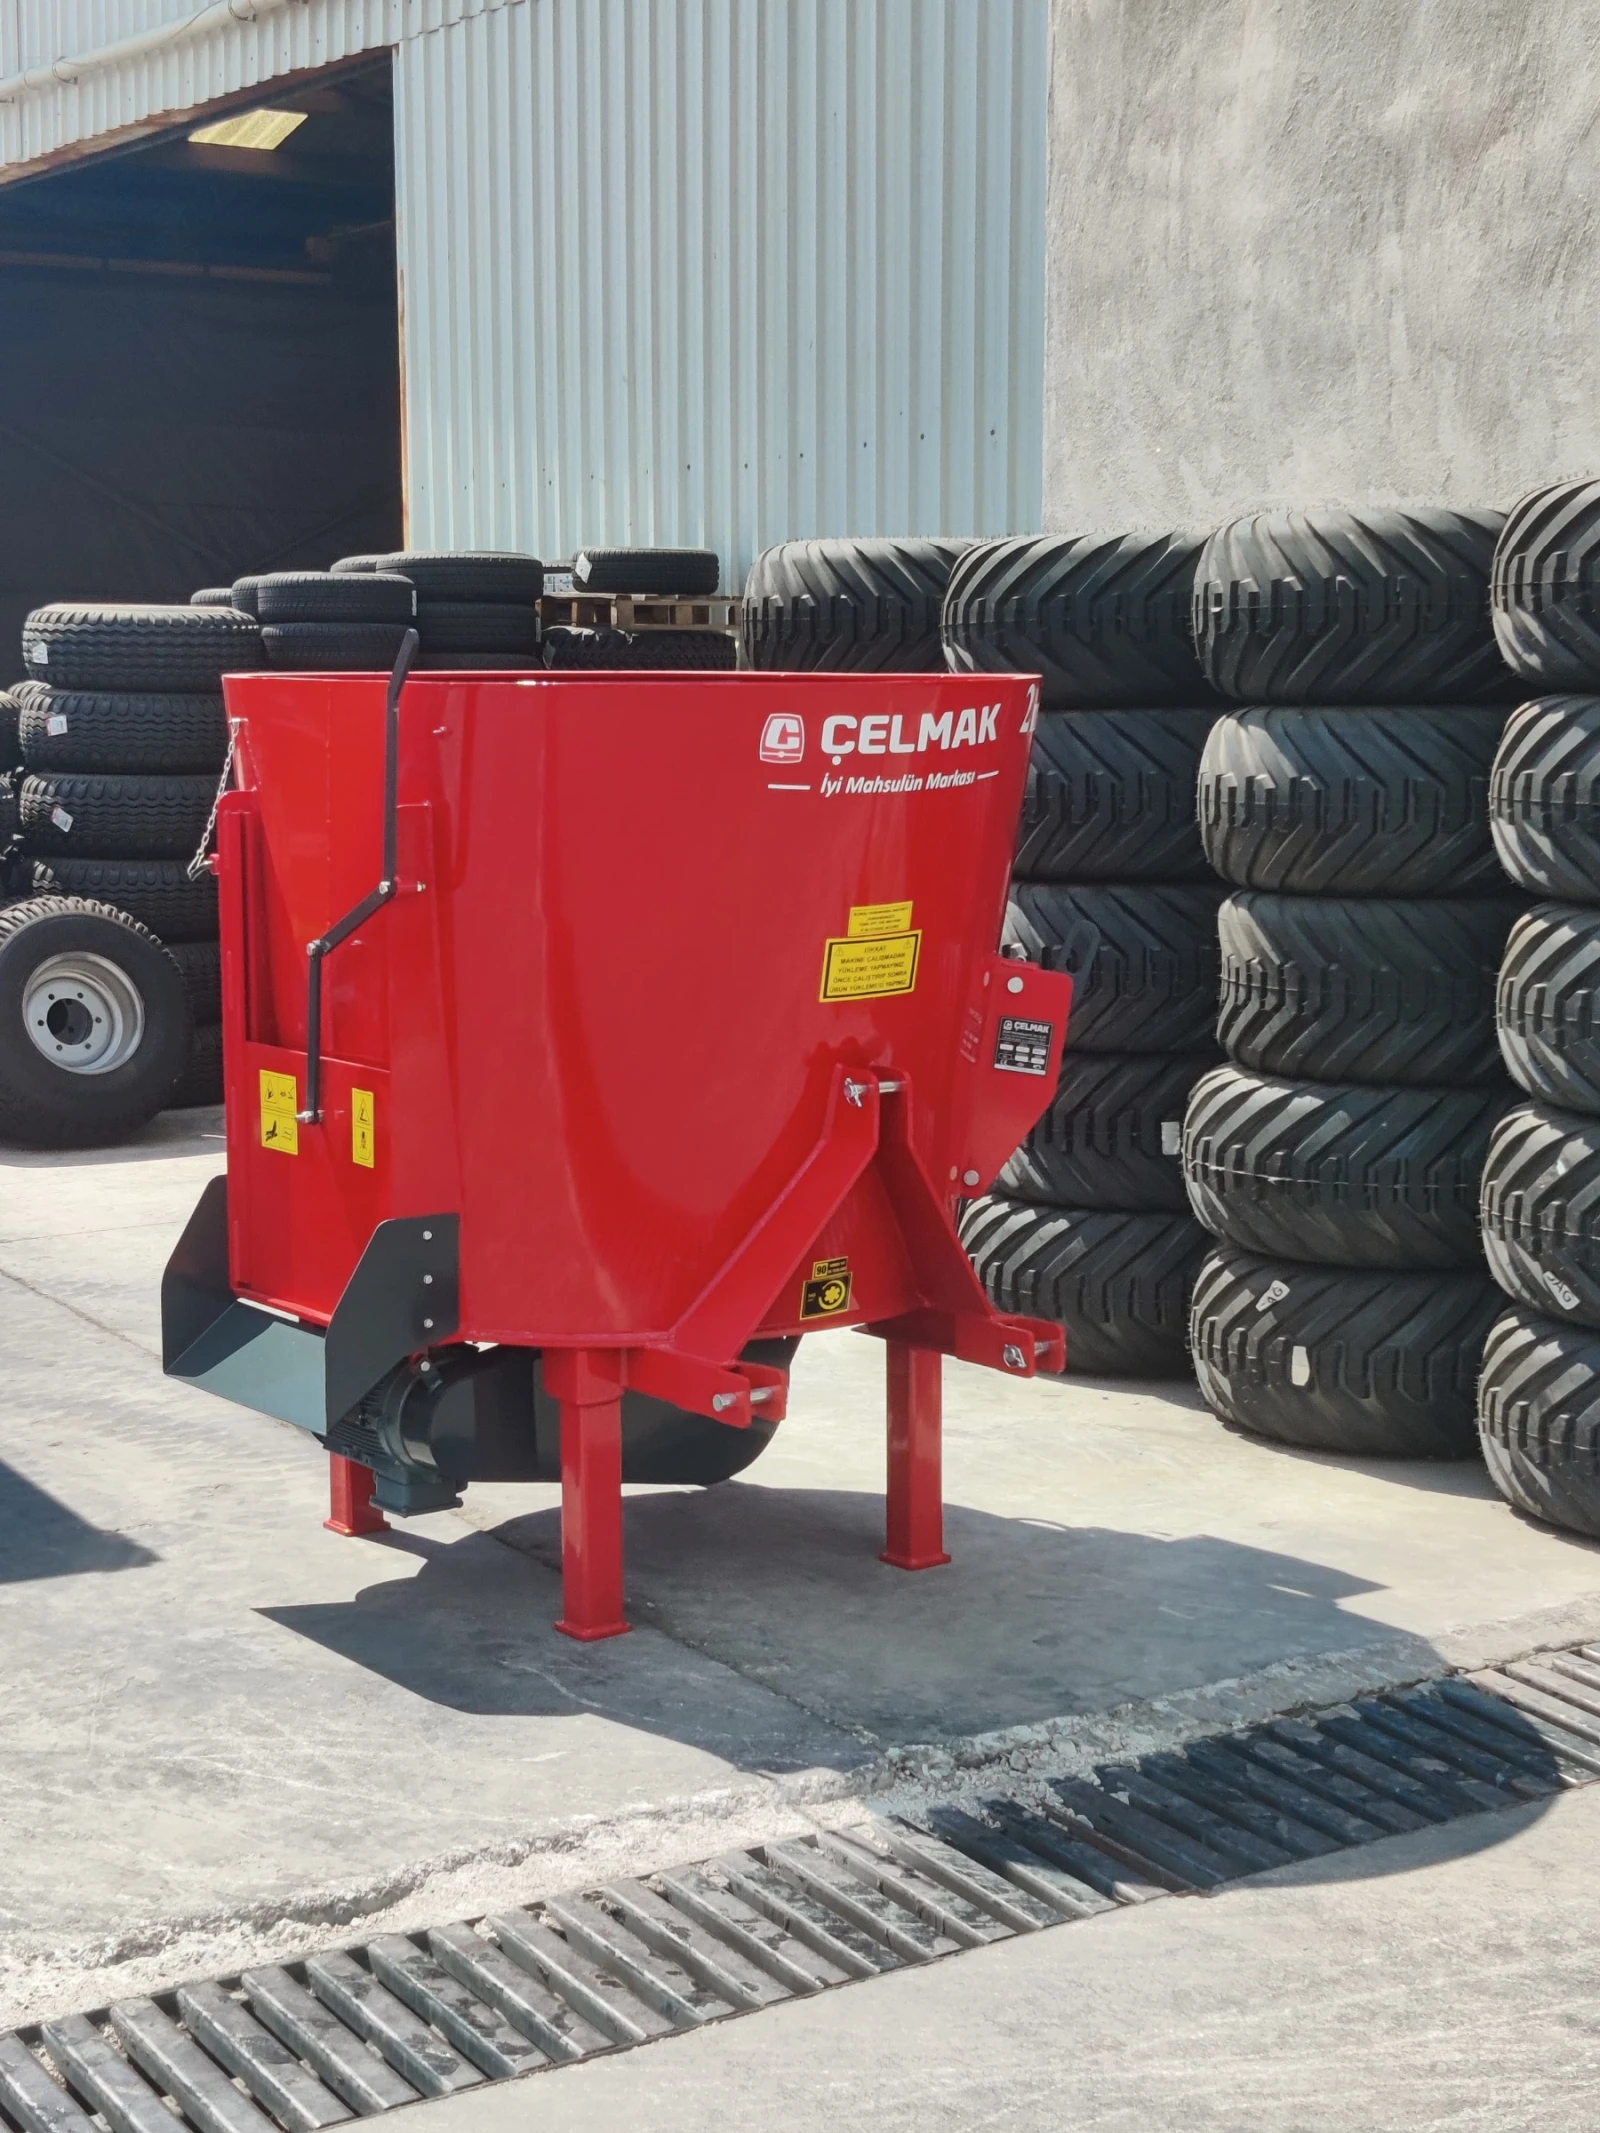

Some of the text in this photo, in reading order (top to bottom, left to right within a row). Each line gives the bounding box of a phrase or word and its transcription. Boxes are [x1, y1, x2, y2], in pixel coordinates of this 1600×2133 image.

[821, 703, 1001, 766] ÇELMAK
[820, 770, 976, 798] İyi Mahsulün Markası
[1014, 1021, 1050, 1034] ÇELMAK
[816, 1265, 827, 1276] 90
